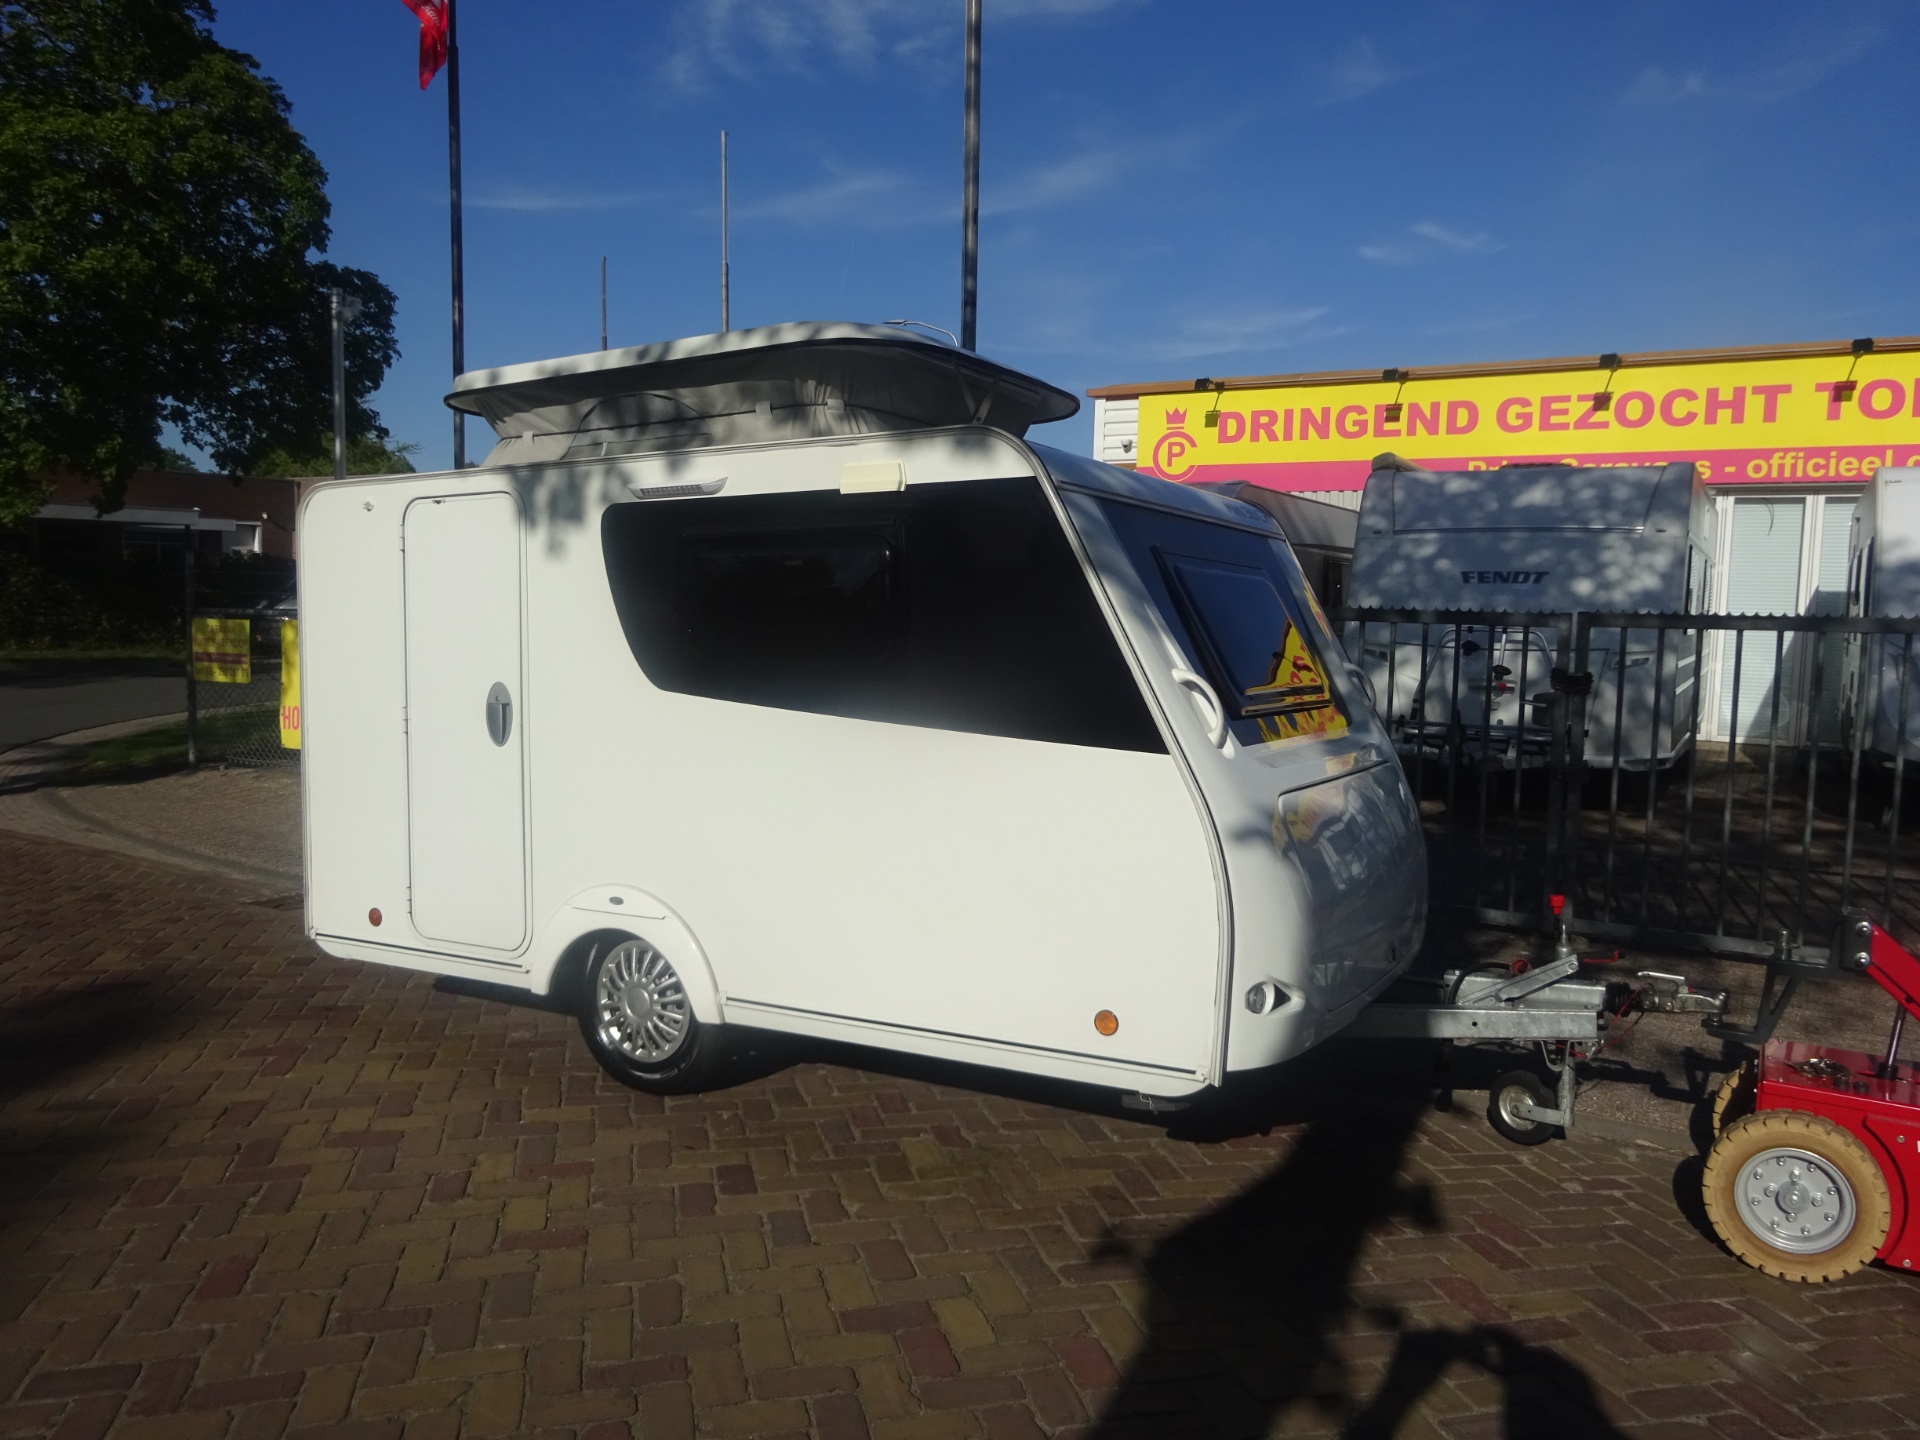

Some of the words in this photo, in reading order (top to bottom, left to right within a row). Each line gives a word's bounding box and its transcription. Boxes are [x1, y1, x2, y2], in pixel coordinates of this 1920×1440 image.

[1217, 400, 1480, 444] DRINGEND
[1496, 383, 1793, 434] GEZOCHT
[1814, 377, 1920, 421] TO
[1746, 448, 1894, 479] officieel
[1460, 570, 1550, 585] FENDT
